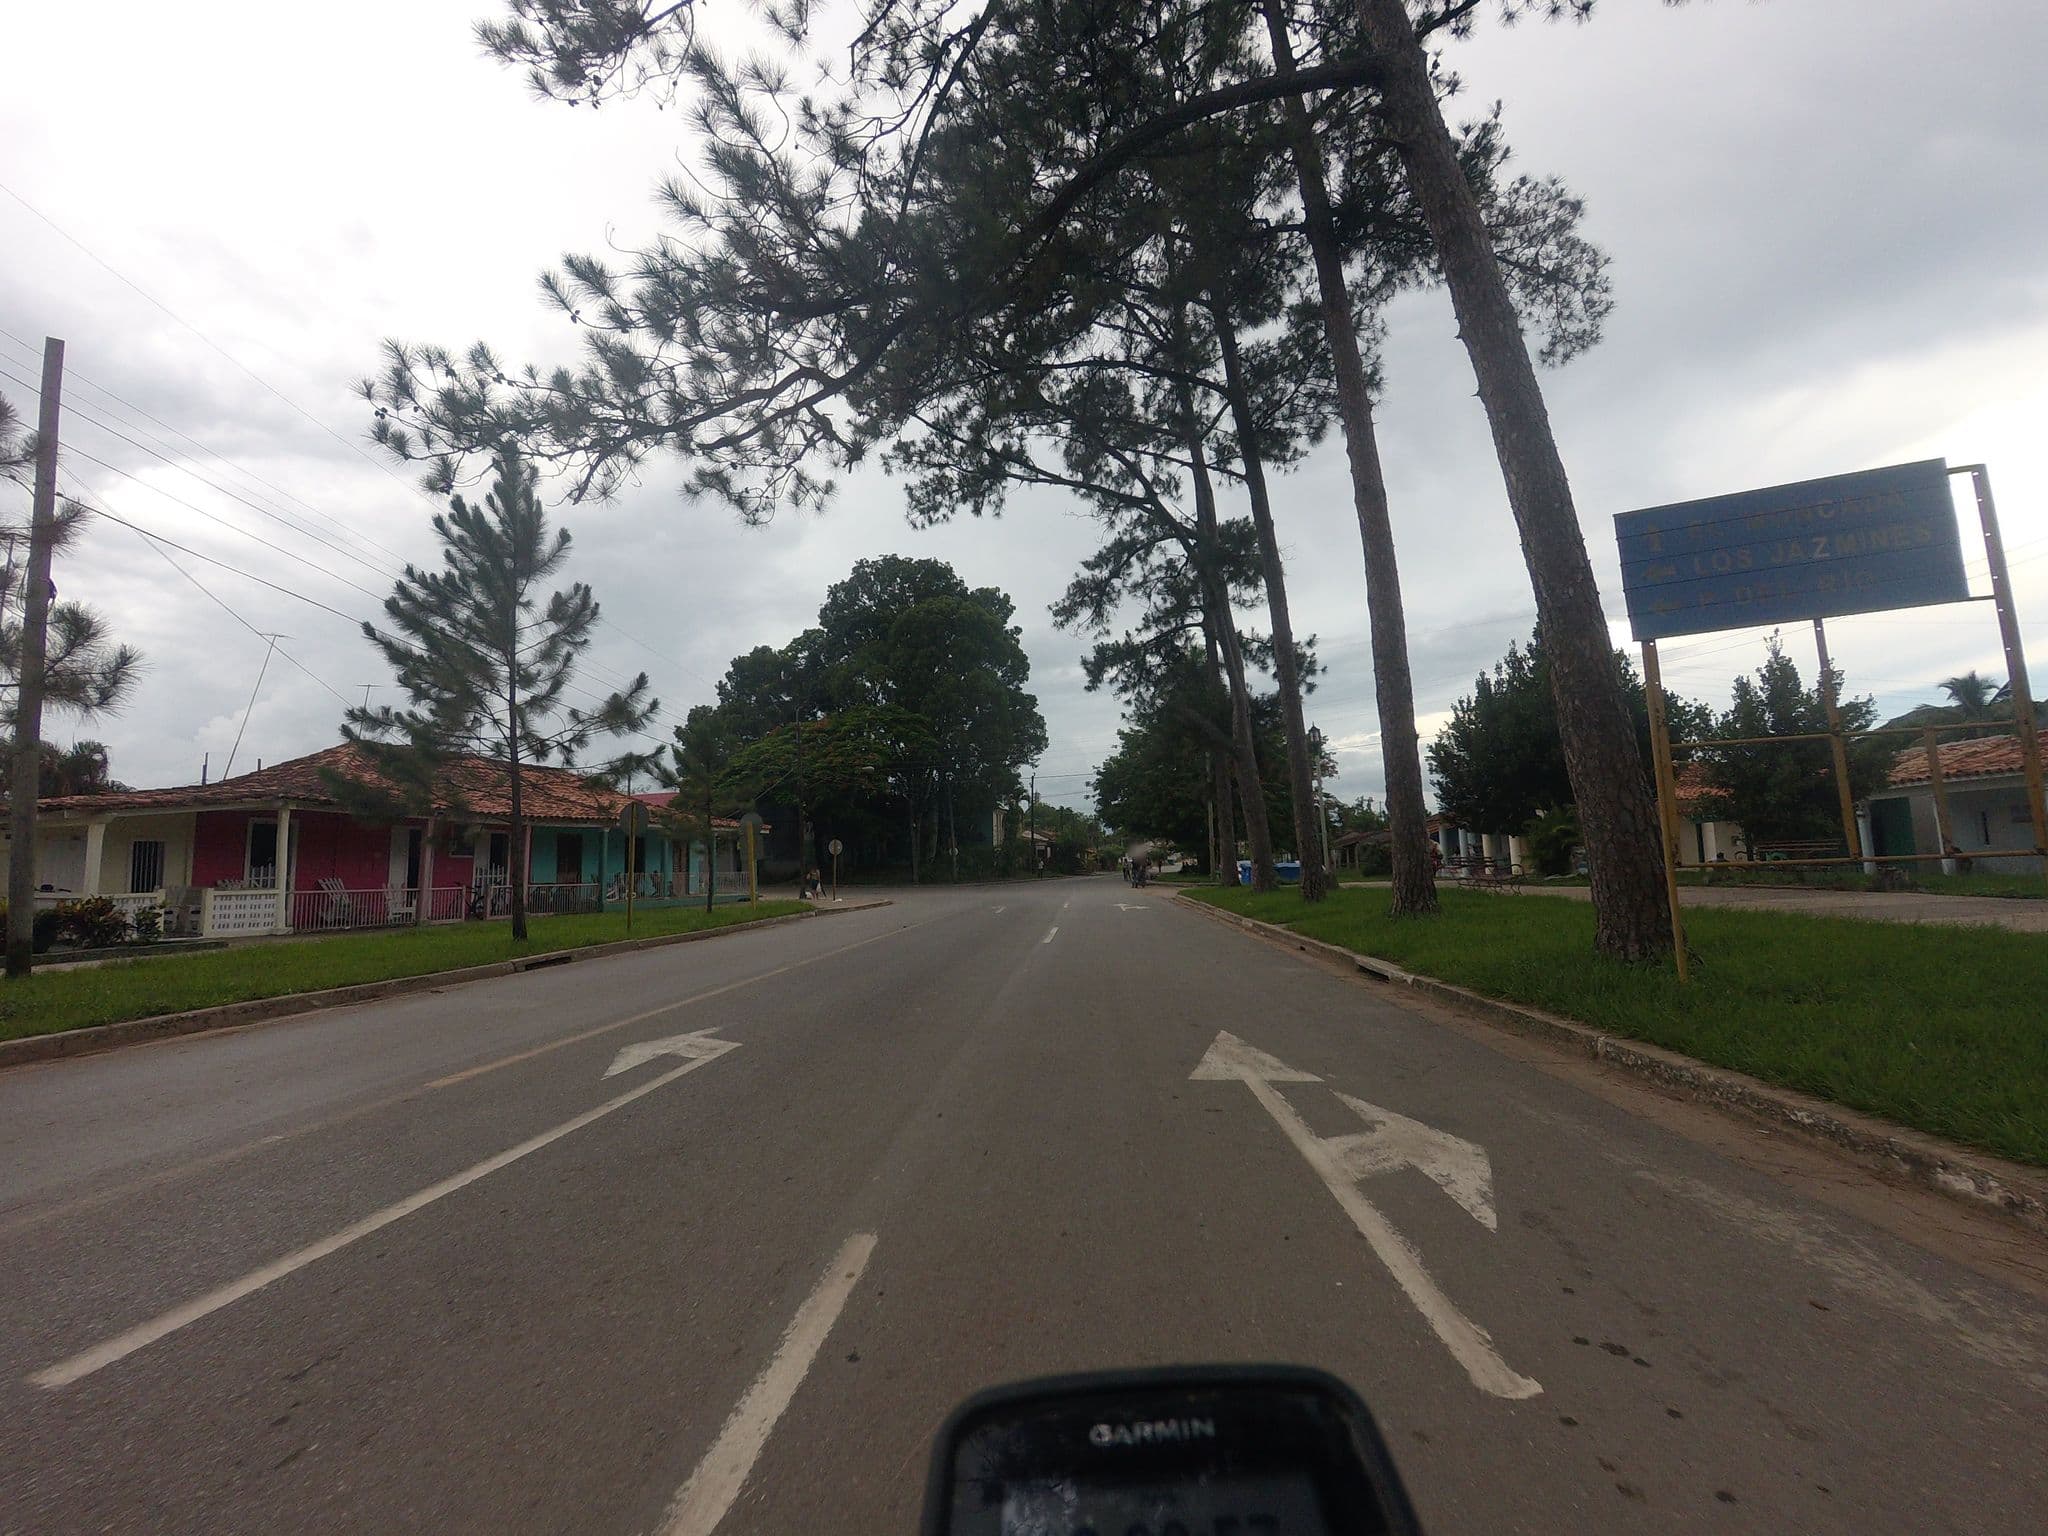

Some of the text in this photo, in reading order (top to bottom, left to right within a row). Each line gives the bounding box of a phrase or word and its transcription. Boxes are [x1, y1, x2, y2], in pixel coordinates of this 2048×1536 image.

[1693, 520, 1932, 576] LOS JAZMINES
[1089, 1420, 1215, 1447] GARMIN
